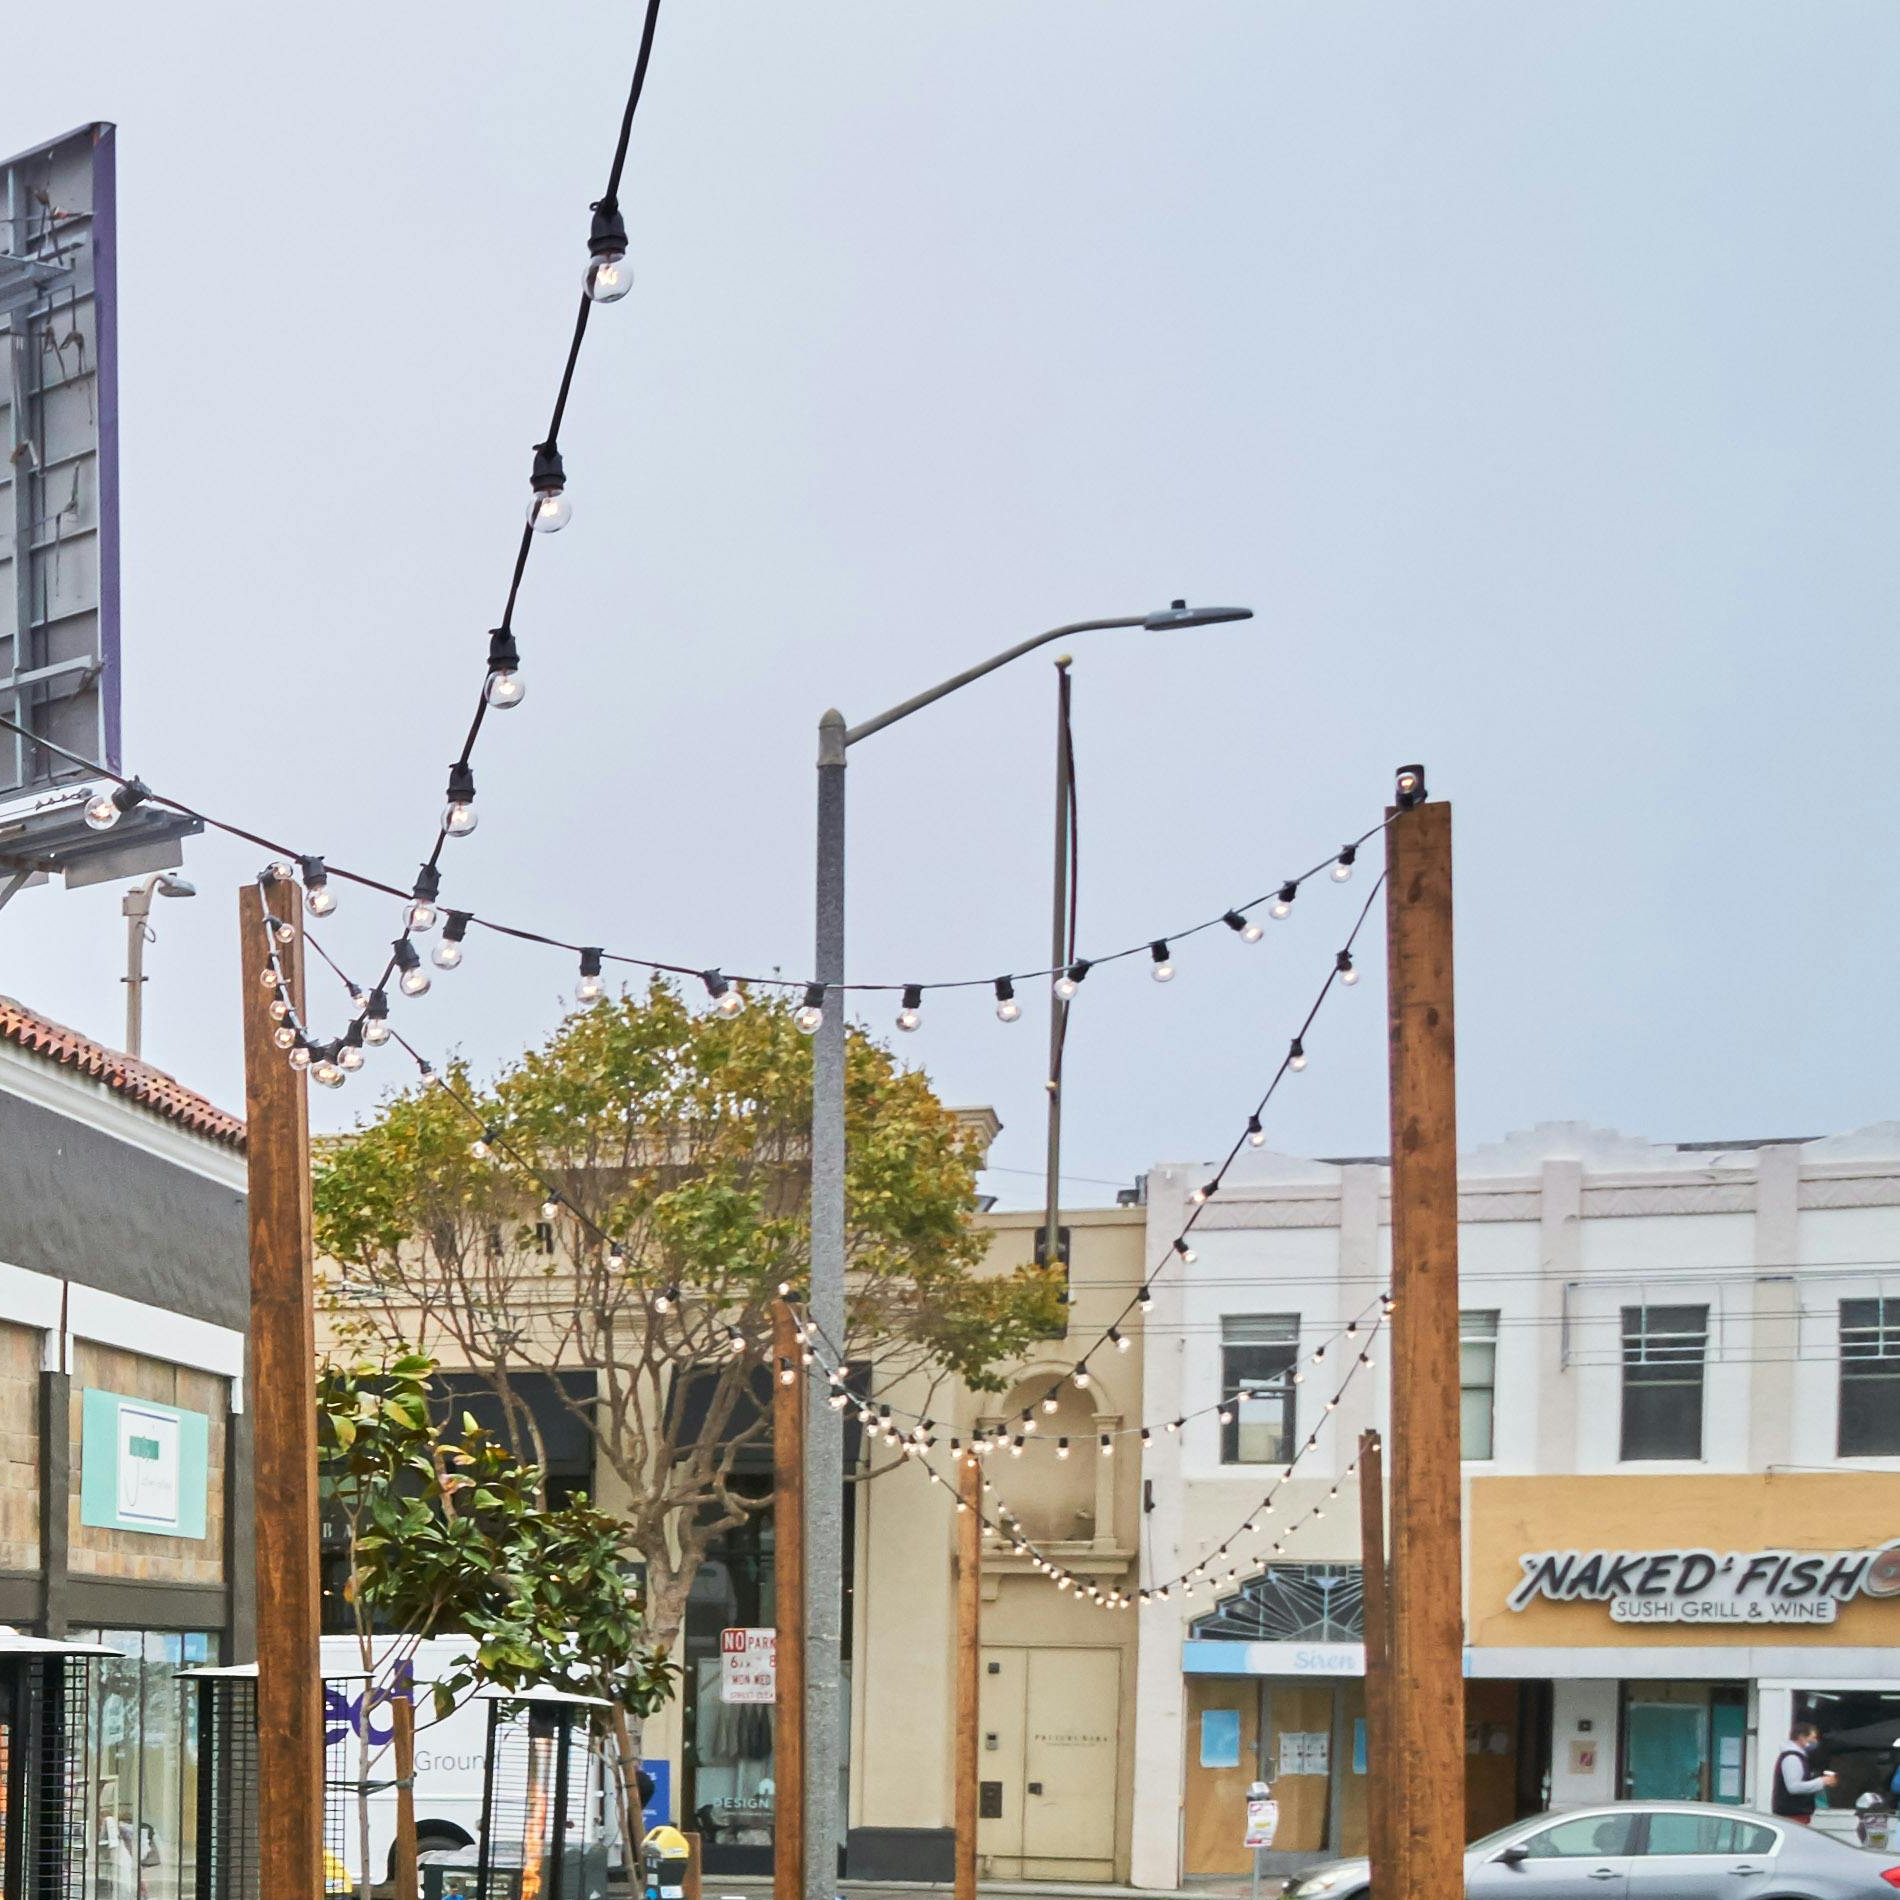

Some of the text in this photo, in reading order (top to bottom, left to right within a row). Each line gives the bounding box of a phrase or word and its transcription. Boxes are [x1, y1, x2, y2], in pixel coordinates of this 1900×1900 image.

[1735, 1555, 1871, 1597] FISH
[1617, 1601, 1828, 1619] SUSHI GRILL & WINE
[724, 1631, 776, 1651] NO PARK
[1294, 1651, 1355, 1669] Siren
